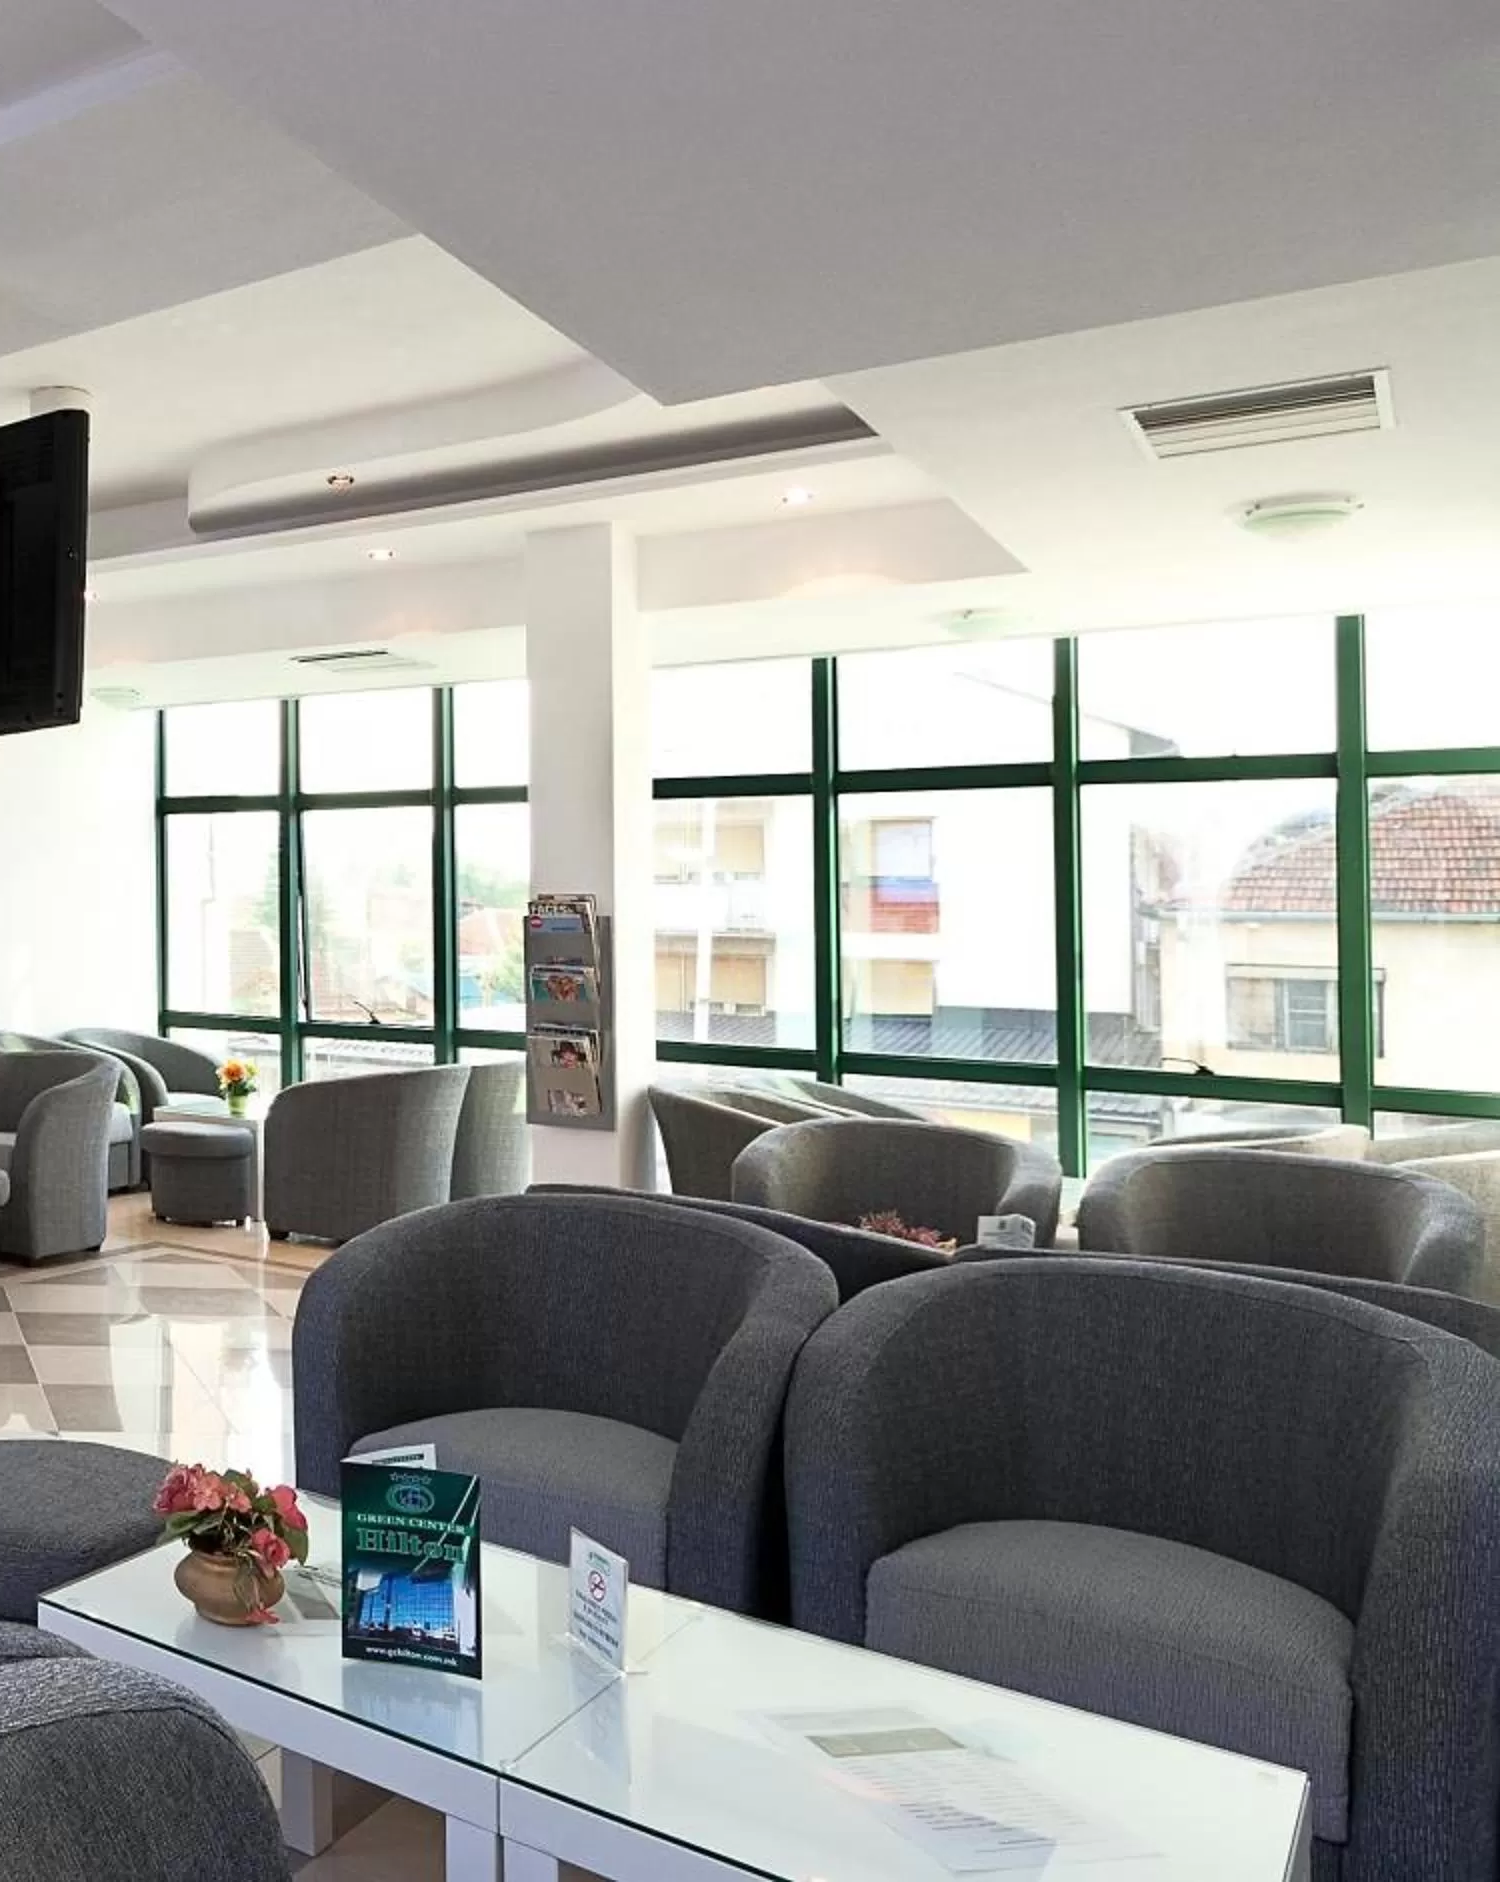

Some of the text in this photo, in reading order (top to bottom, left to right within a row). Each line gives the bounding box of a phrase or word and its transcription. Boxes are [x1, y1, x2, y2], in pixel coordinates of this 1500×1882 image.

[357, 1513, 465, 1535] GREEN CENTER
[356, 1527, 463, 1561] Hilton
